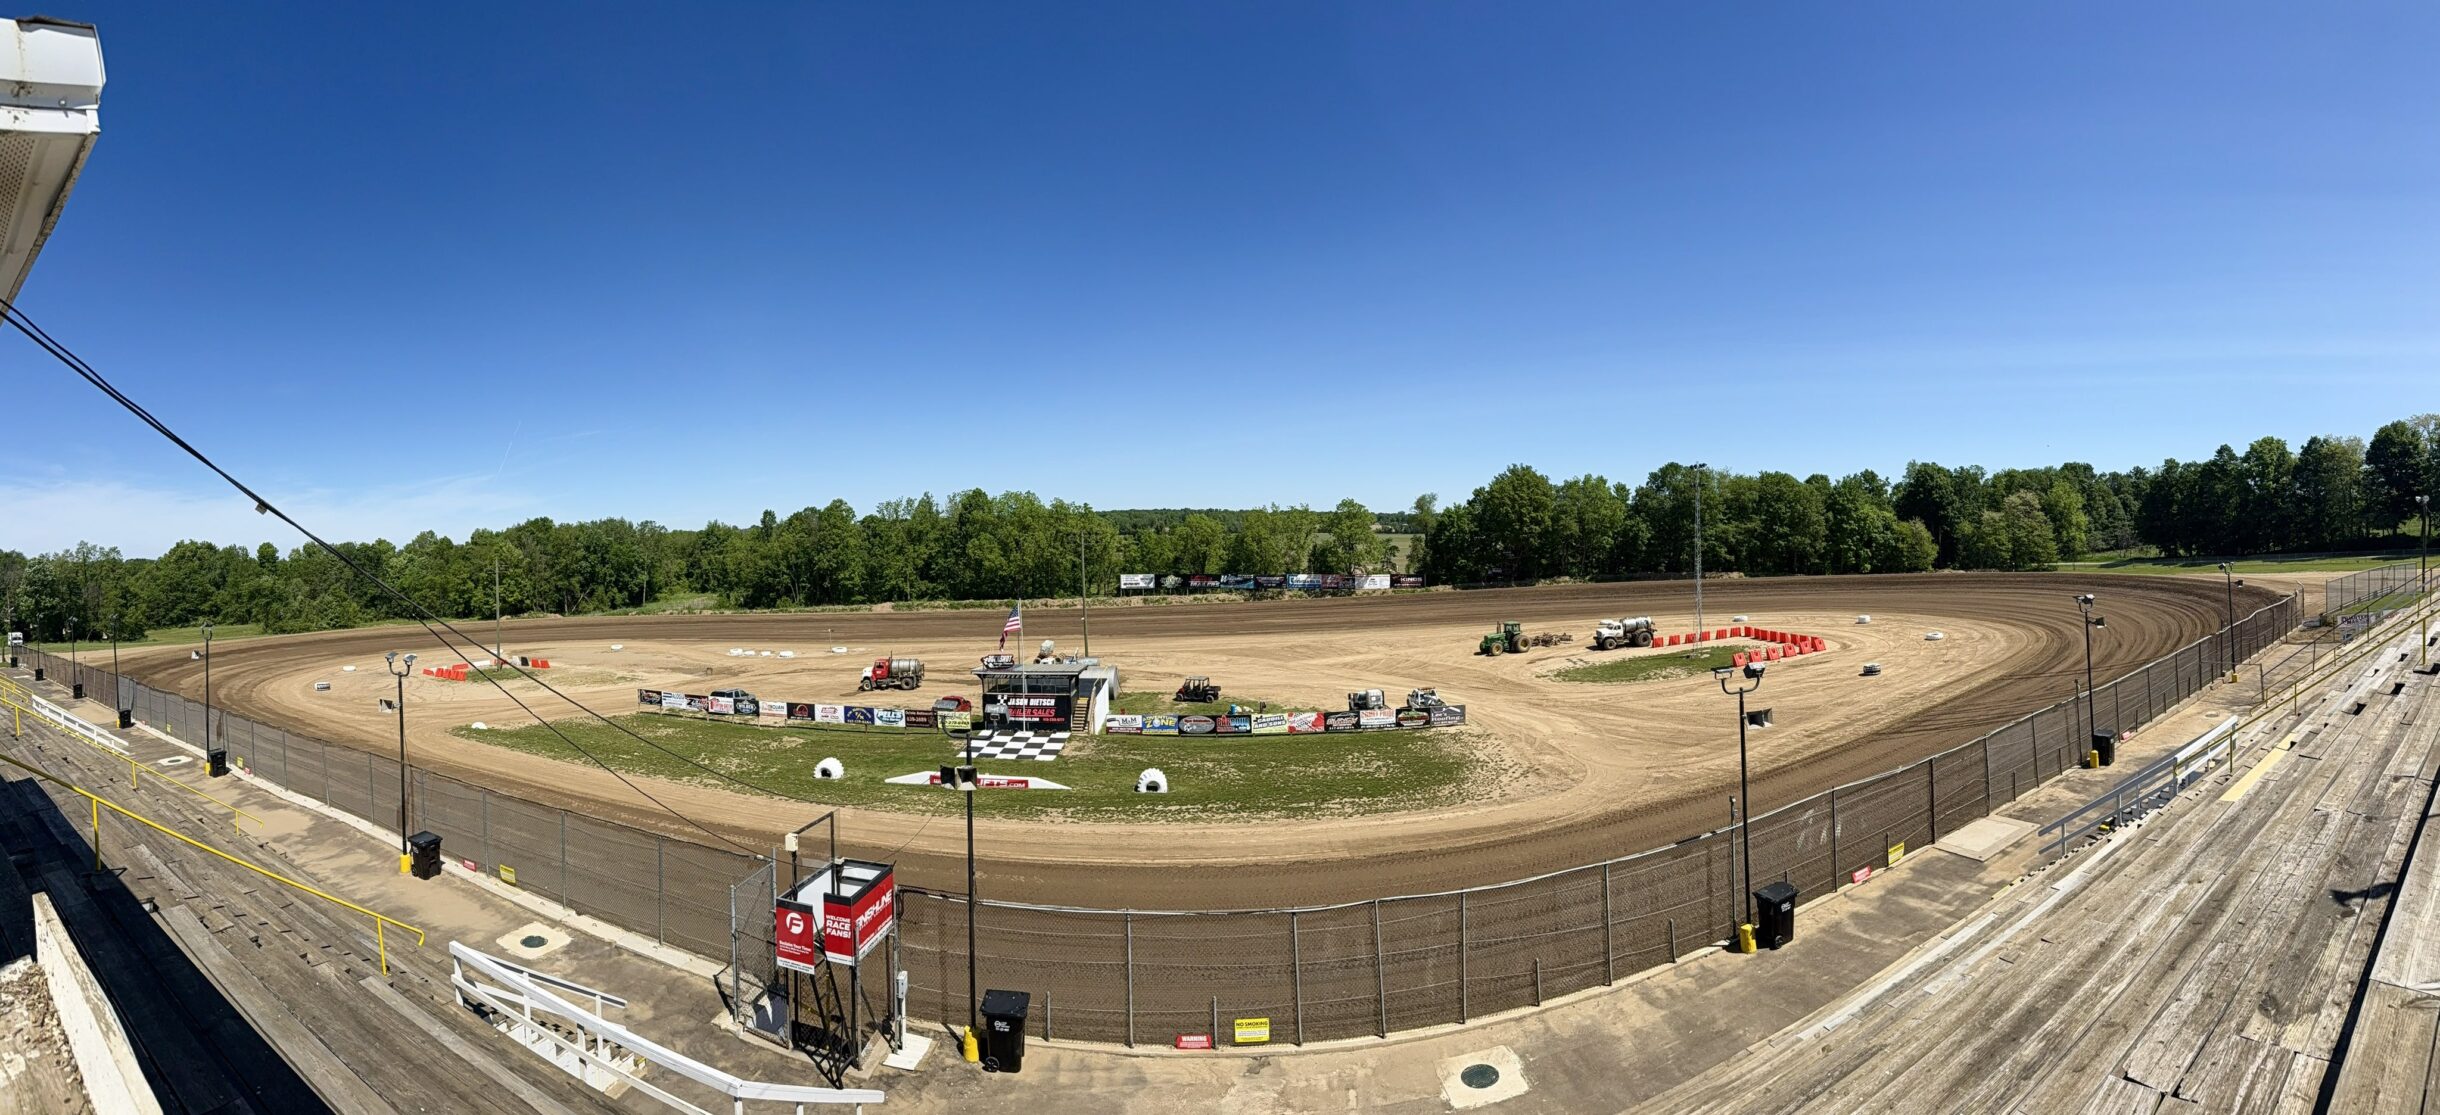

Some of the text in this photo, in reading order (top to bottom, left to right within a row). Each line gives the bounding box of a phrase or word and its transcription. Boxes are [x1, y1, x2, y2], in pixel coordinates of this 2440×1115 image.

[1007, 698, 1055, 706] JASON DIETSCH
[1032, 708, 1055, 717] SALES
[825, 914, 851, 923] WELCOME
[826, 919, 851, 931] RACE
[826, 928, 852, 939] FANS!
